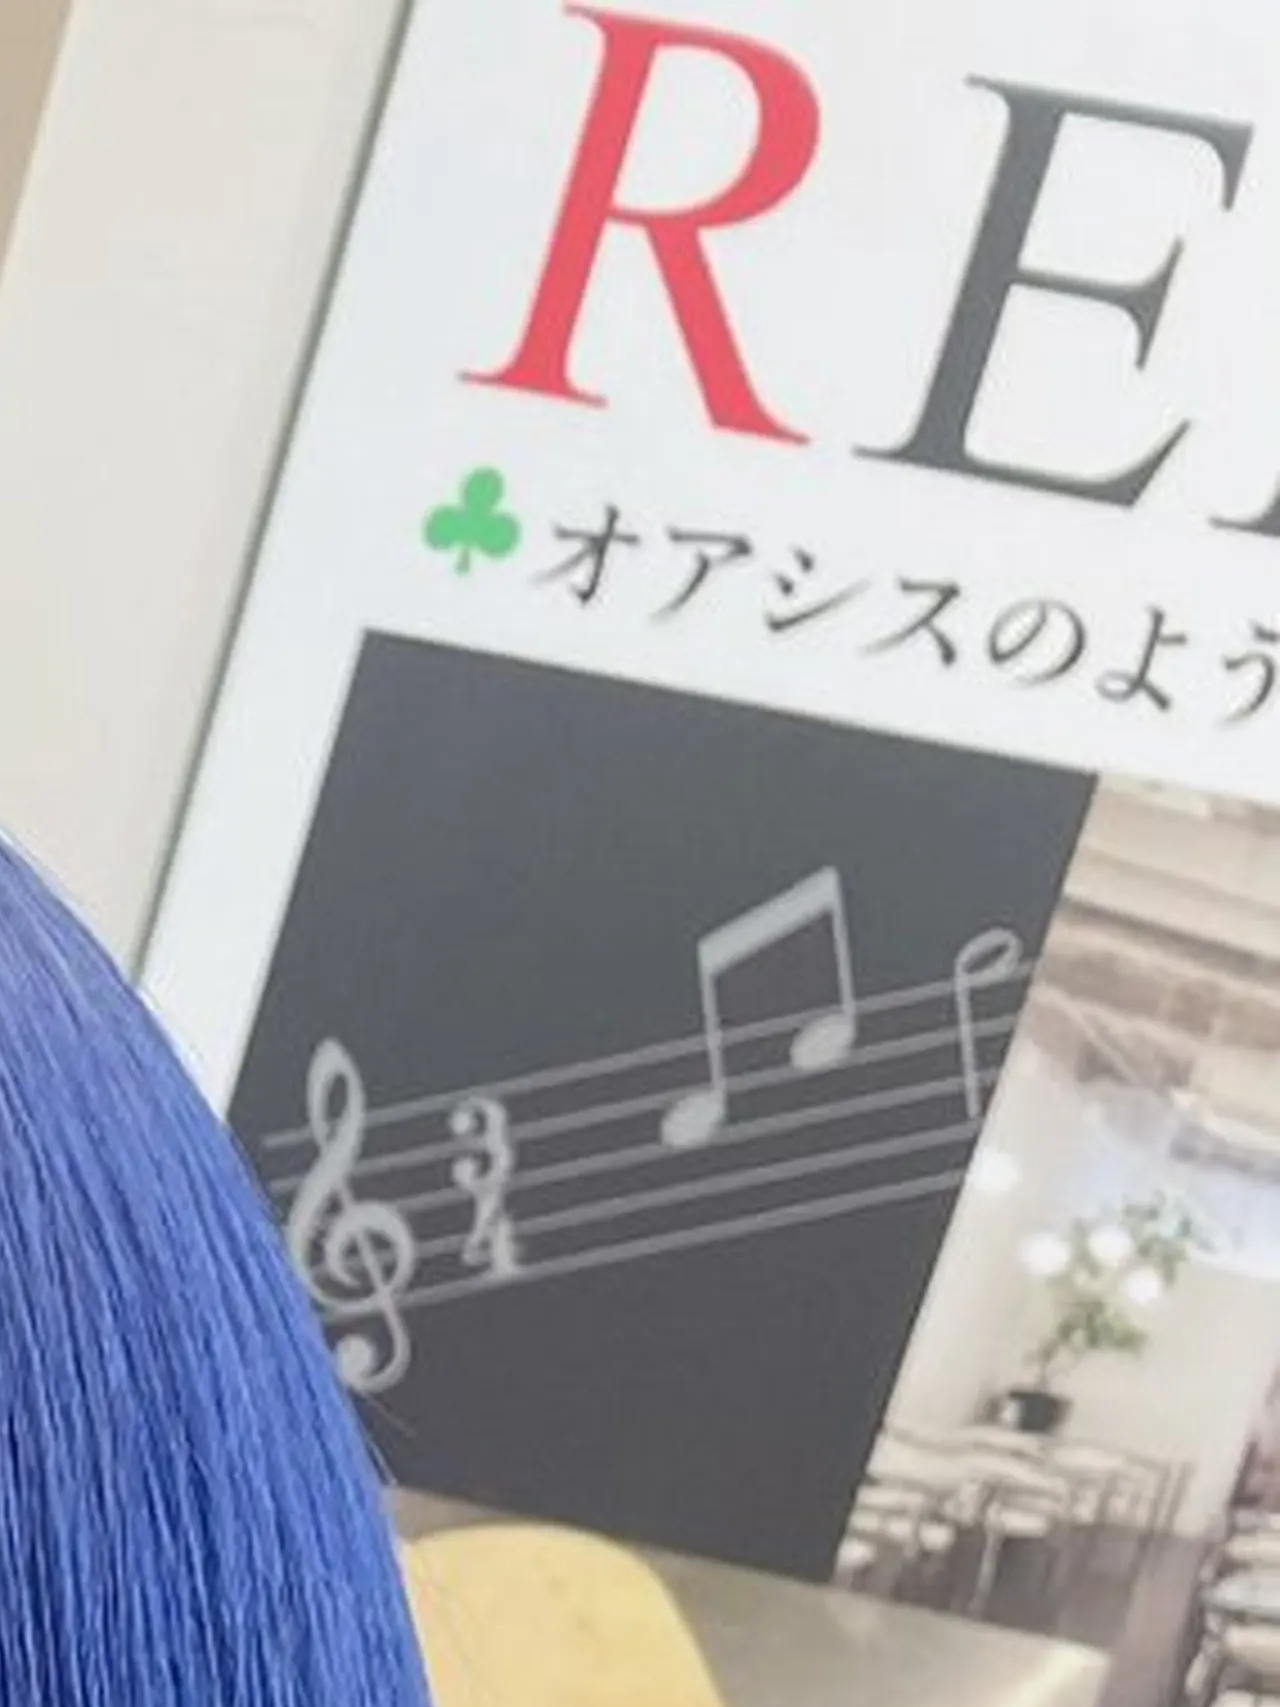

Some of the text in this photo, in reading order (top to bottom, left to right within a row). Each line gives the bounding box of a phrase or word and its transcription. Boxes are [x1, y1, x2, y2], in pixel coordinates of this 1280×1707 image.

[457, 5, 1280, 538] RE
[530, 503, 1280, 727] オアシスのよう
